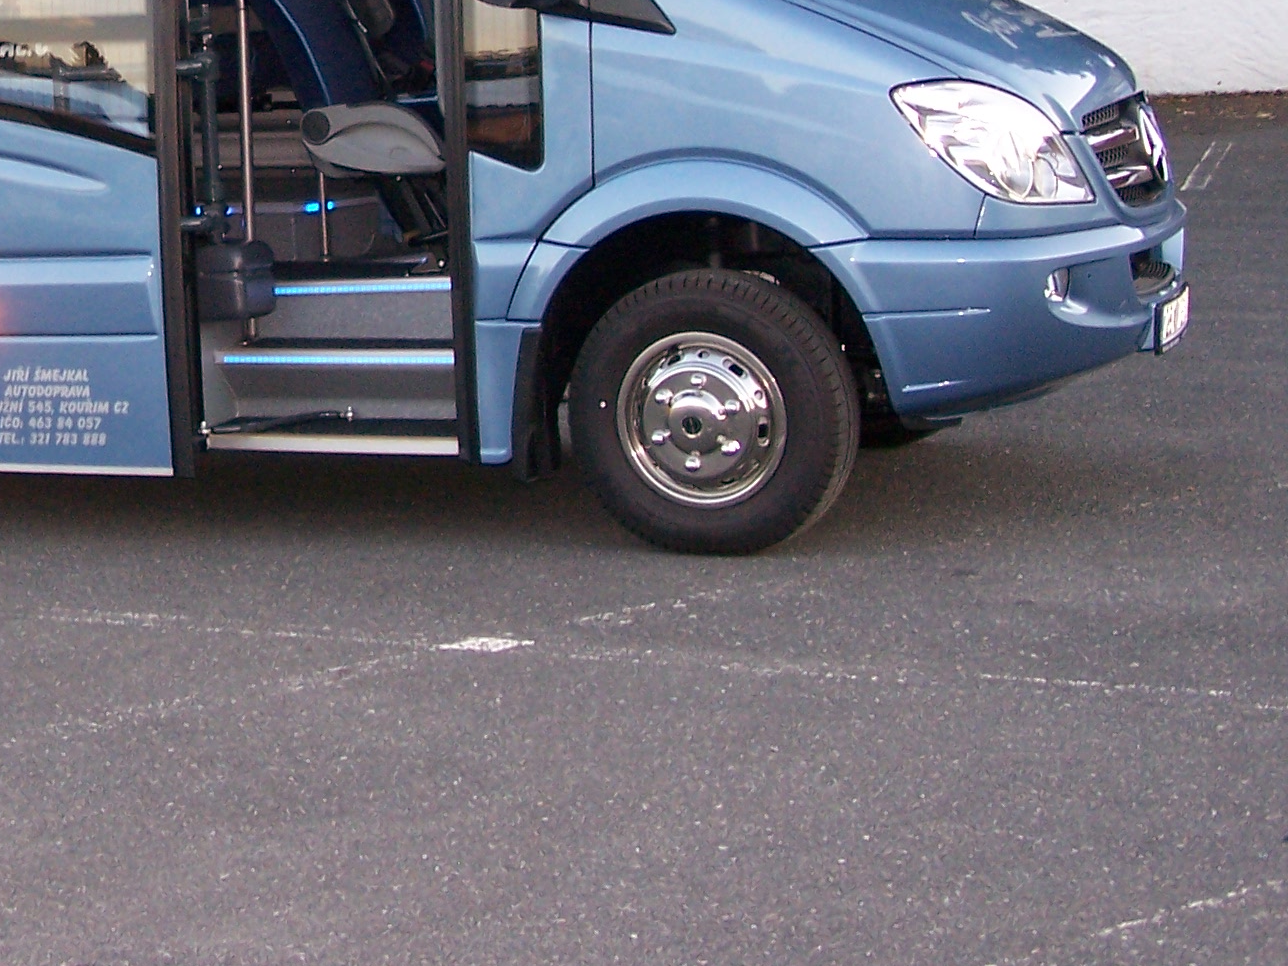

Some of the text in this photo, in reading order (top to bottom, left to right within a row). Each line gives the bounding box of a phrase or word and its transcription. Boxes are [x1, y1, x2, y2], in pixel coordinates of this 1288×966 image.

[33, 366, 90, 382] ŠMEJKAL
[4, 385, 91, 398] AUTODOPRAVA
[114, 401, 130, 414] CZ
[29, 432, 50, 445] 321
